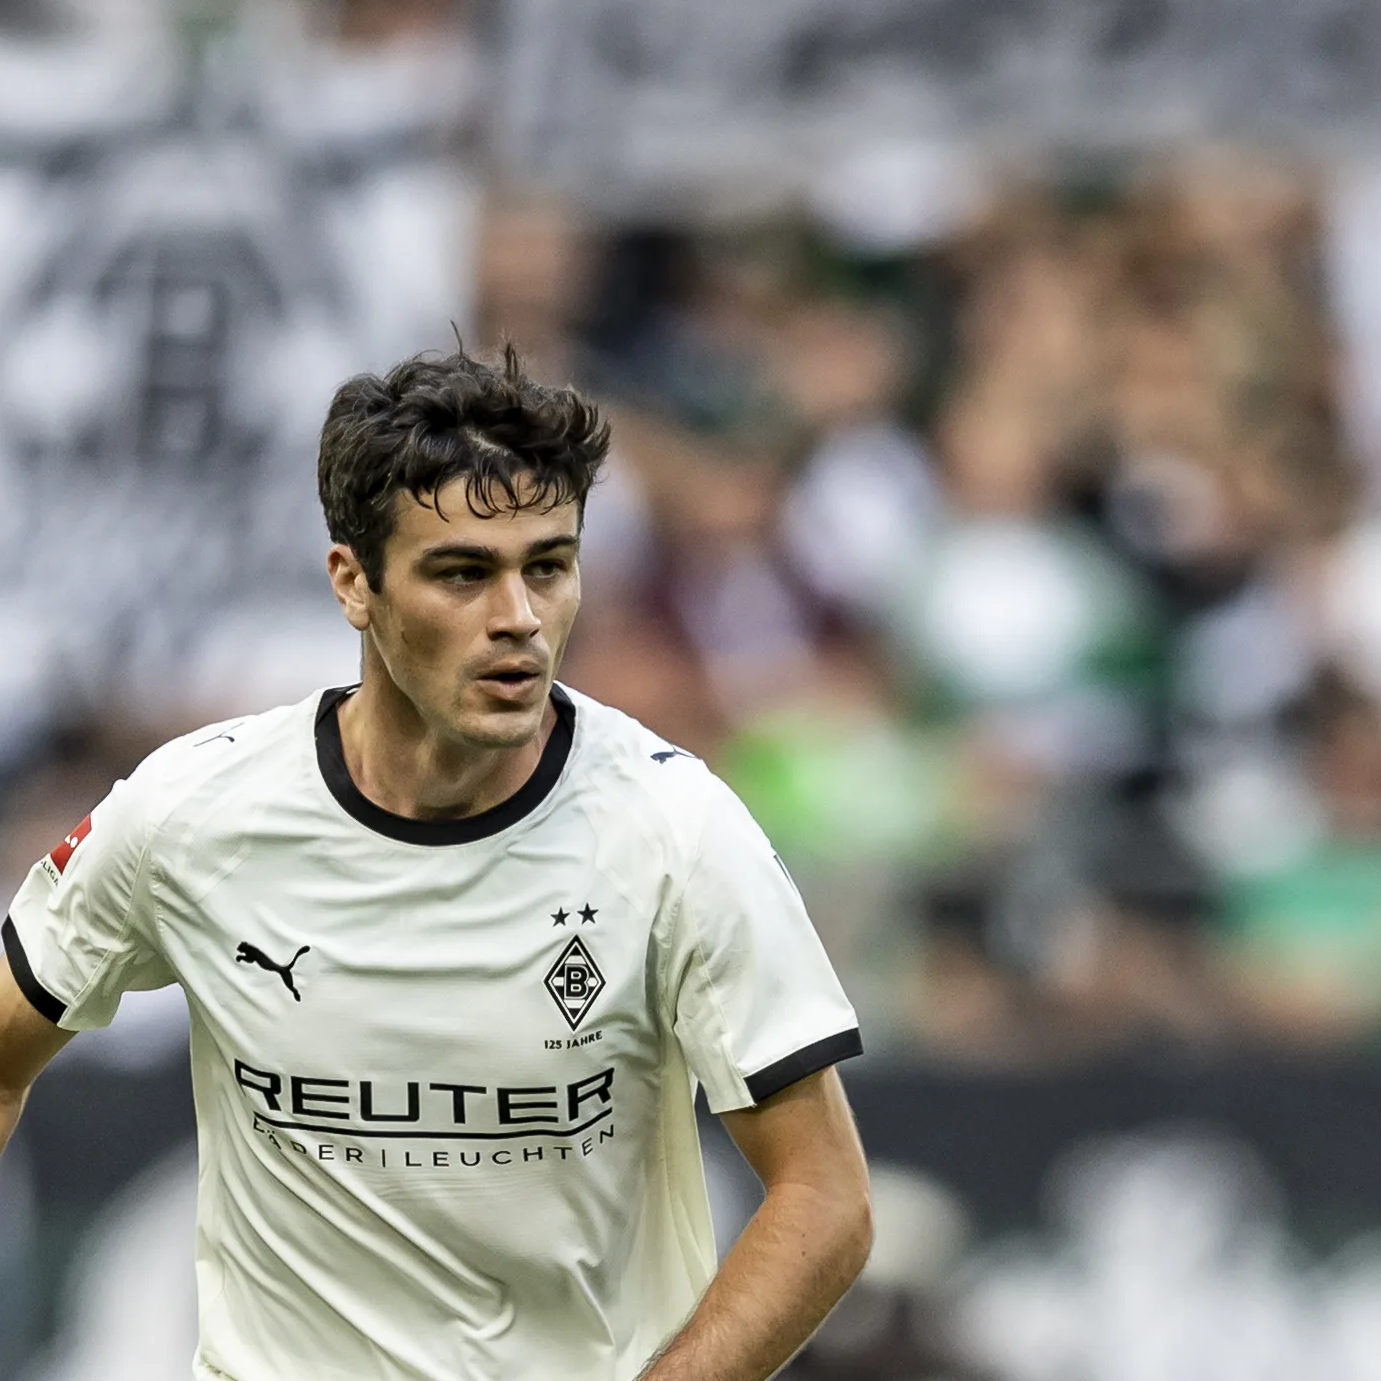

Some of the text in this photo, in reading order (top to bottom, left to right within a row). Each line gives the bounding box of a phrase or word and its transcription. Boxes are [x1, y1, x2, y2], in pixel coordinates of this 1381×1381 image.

[563, 963, 589, 1001] B
[544, 1029, 604, 1050] 125 JAHRE
[233, 1057, 616, 1125] REUTER
[405, 1123, 615, 1167] LEUCHTEN
